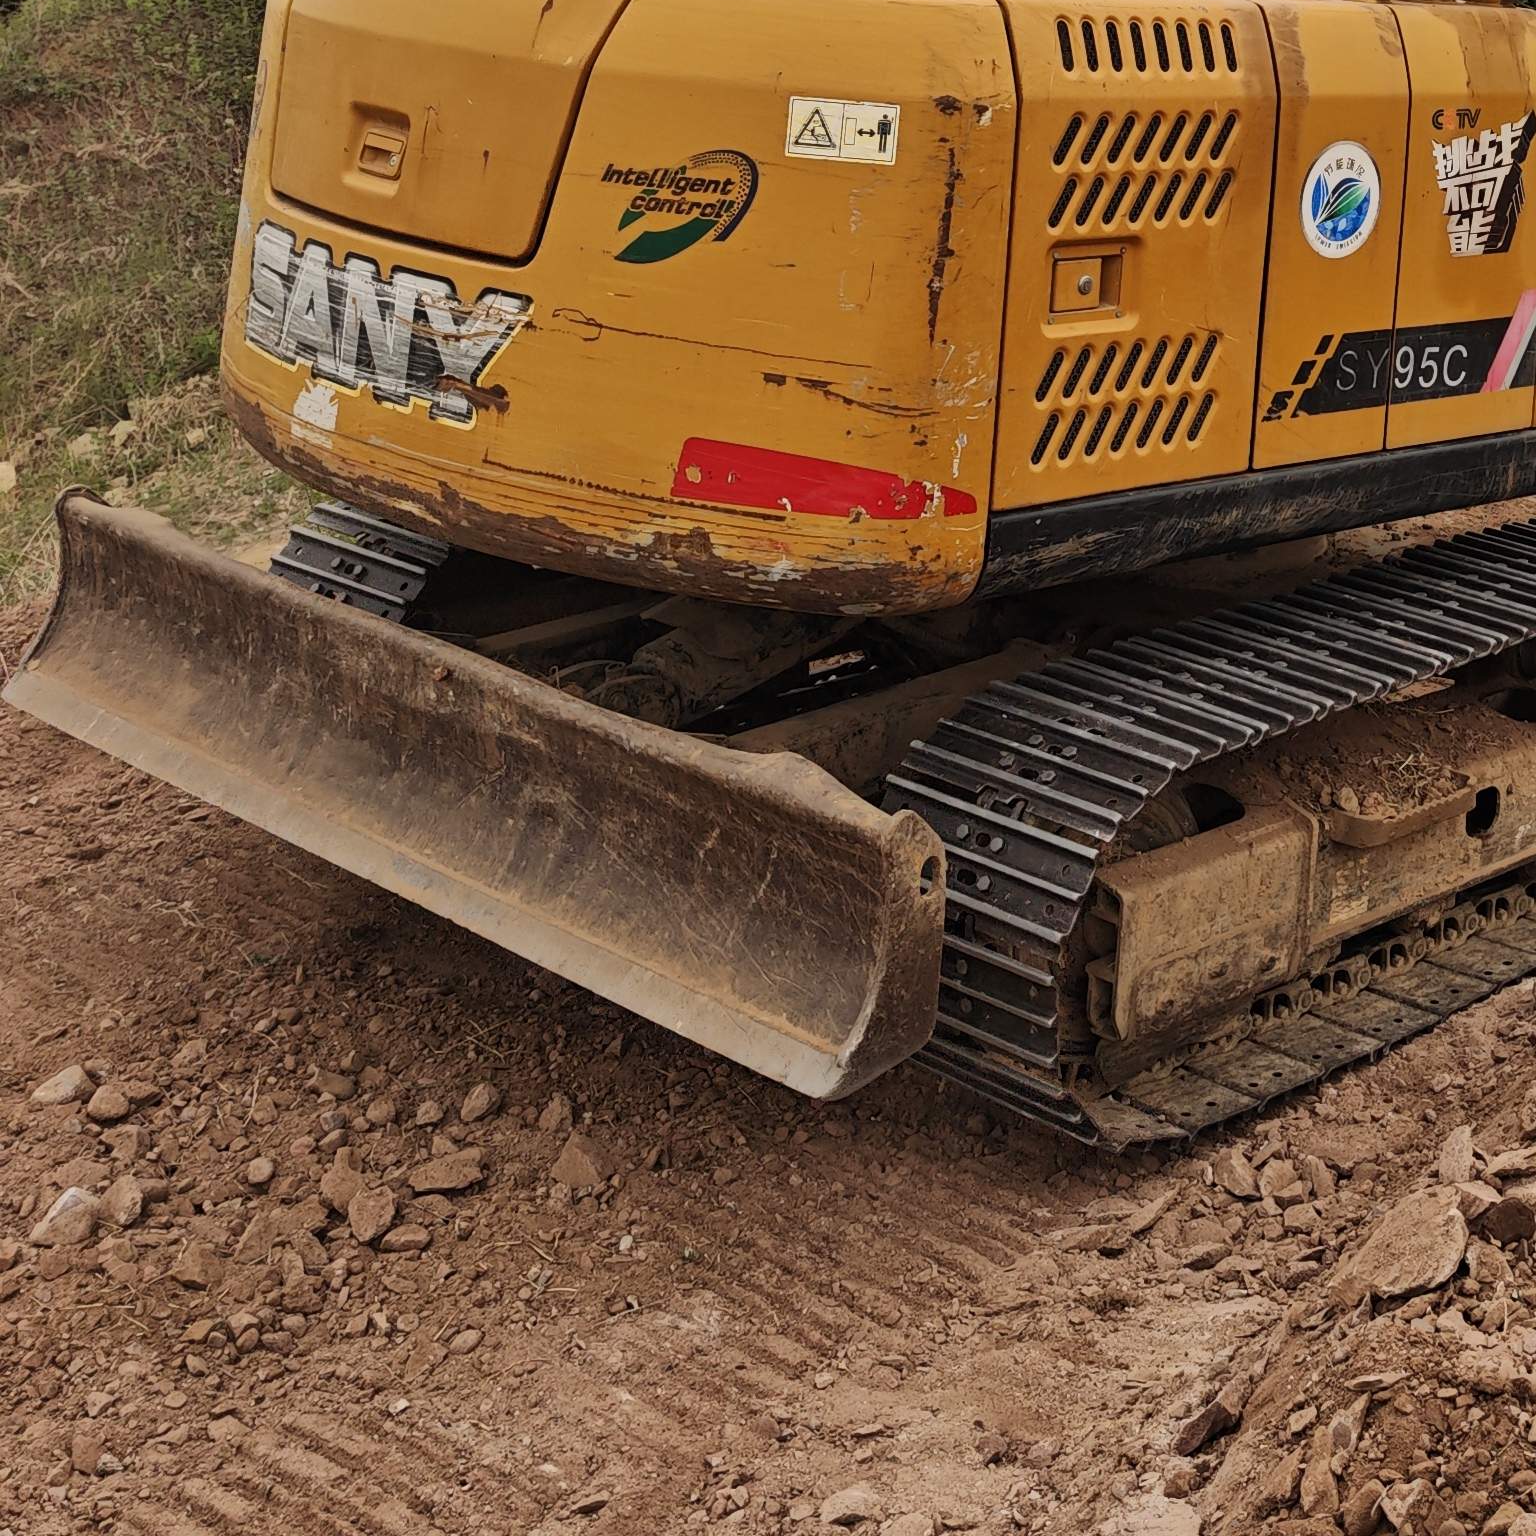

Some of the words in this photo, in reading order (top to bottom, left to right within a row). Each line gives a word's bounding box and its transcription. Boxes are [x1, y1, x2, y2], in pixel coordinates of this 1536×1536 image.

[600, 163, 736, 196] Intelligent
[630, 194, 724, 219] control
[246, 218, 534, 430] SANY
[1336, 344, 1468, 391] SY95C
